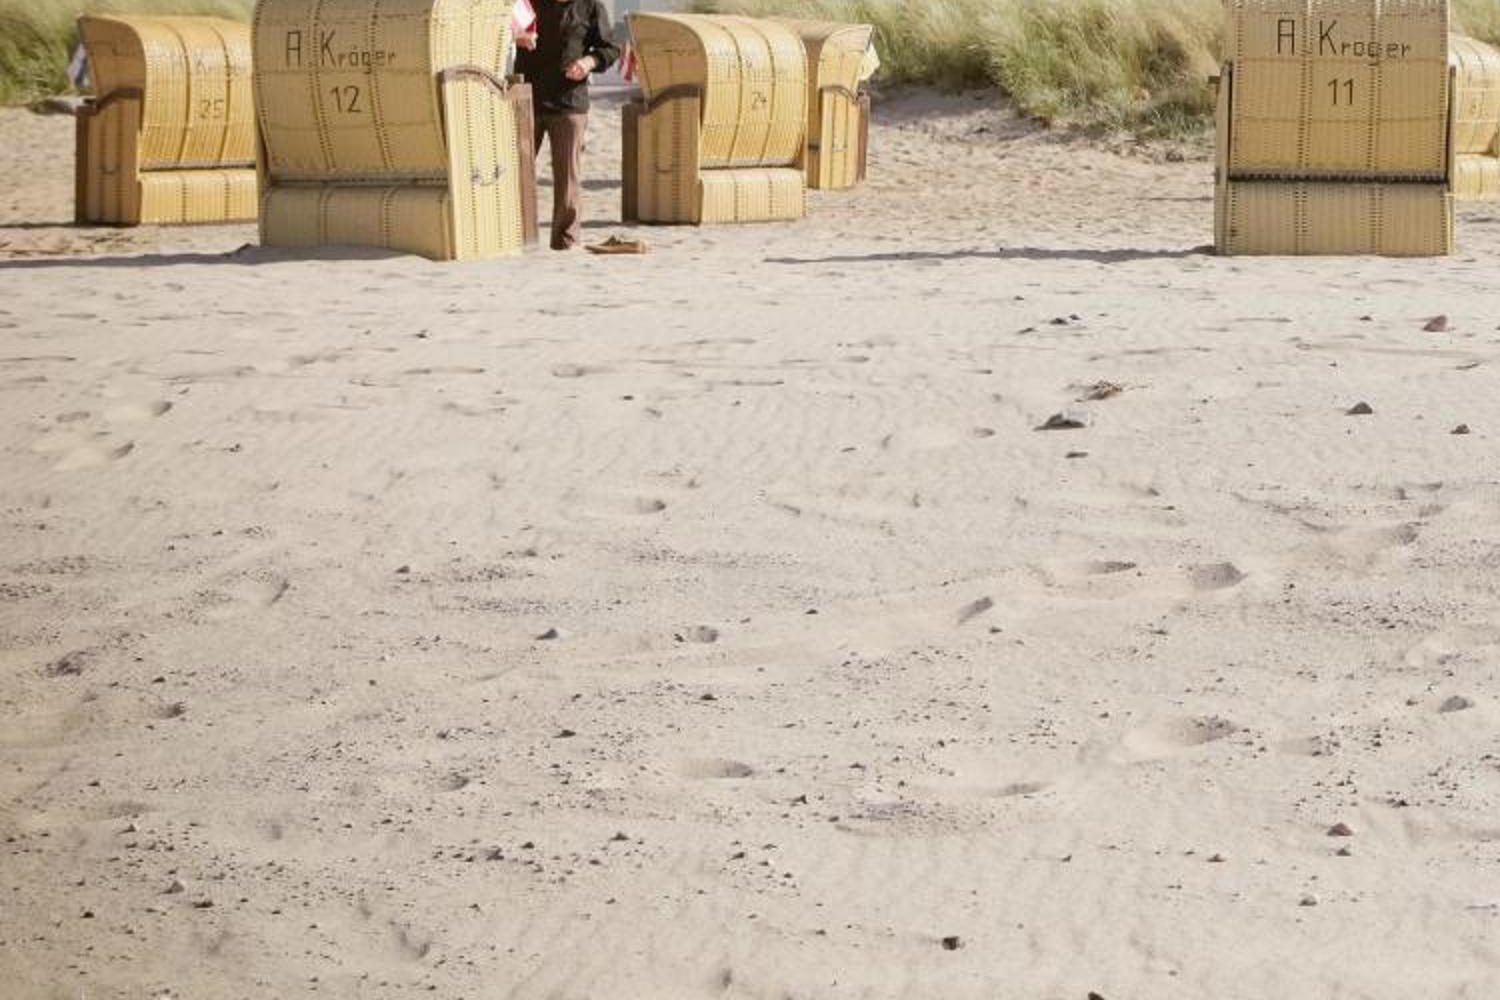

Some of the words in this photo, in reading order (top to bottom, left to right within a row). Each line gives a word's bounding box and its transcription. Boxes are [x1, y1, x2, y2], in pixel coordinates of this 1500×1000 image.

[286, 29, 301, 67] A
[1277, 19, 1295, 55] A
[329, 85, 363, 114] 12
[1327, 78, 1354, 105] 11
